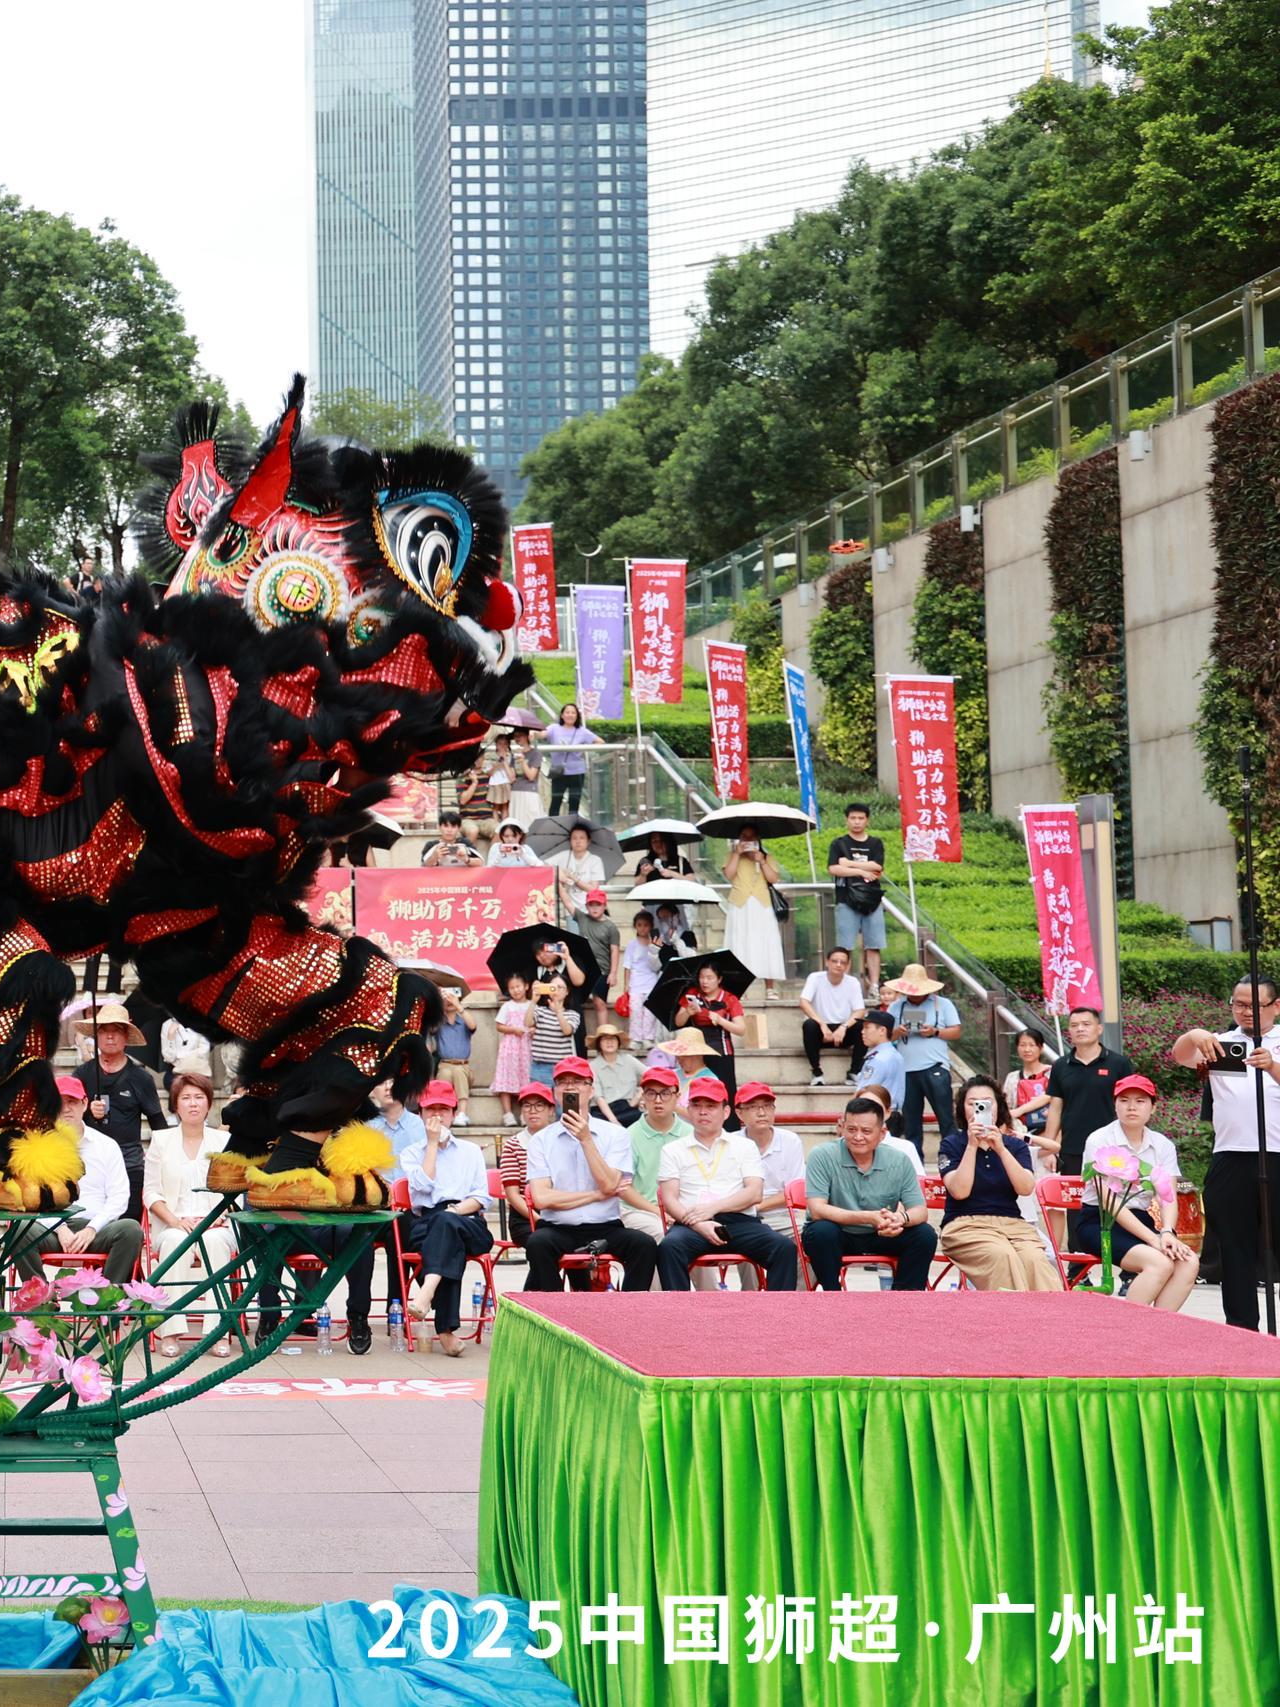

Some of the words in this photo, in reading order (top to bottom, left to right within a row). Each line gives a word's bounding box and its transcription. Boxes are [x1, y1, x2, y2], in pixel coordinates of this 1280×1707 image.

[908, 729, 932, 826] 狮助百千万
[927, 748, 952, 845] 活力满全城
[387, 897, 502, 922] 狮助百千万
[410, 924, 508, 950] 活力满全
